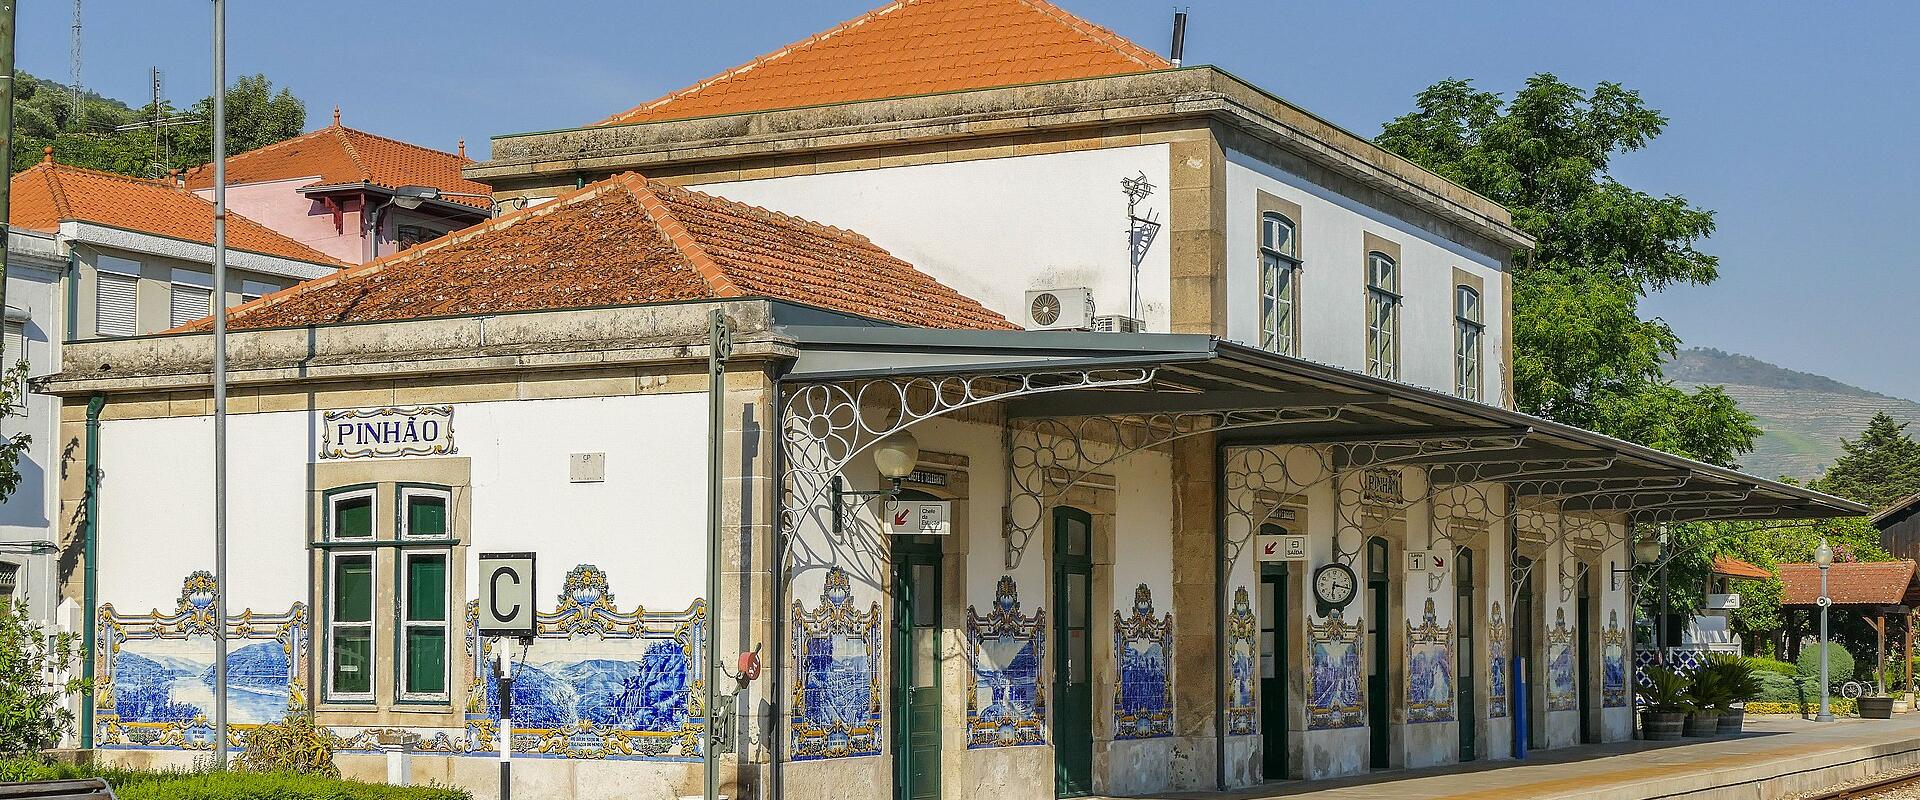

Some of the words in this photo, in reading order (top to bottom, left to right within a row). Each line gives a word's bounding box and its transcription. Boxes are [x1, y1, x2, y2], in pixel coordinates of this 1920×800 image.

[337, 417, 439, 446] PINHÃO
[1413, 558, 1419, 569] 1
[490, 566, 521, 622] C
